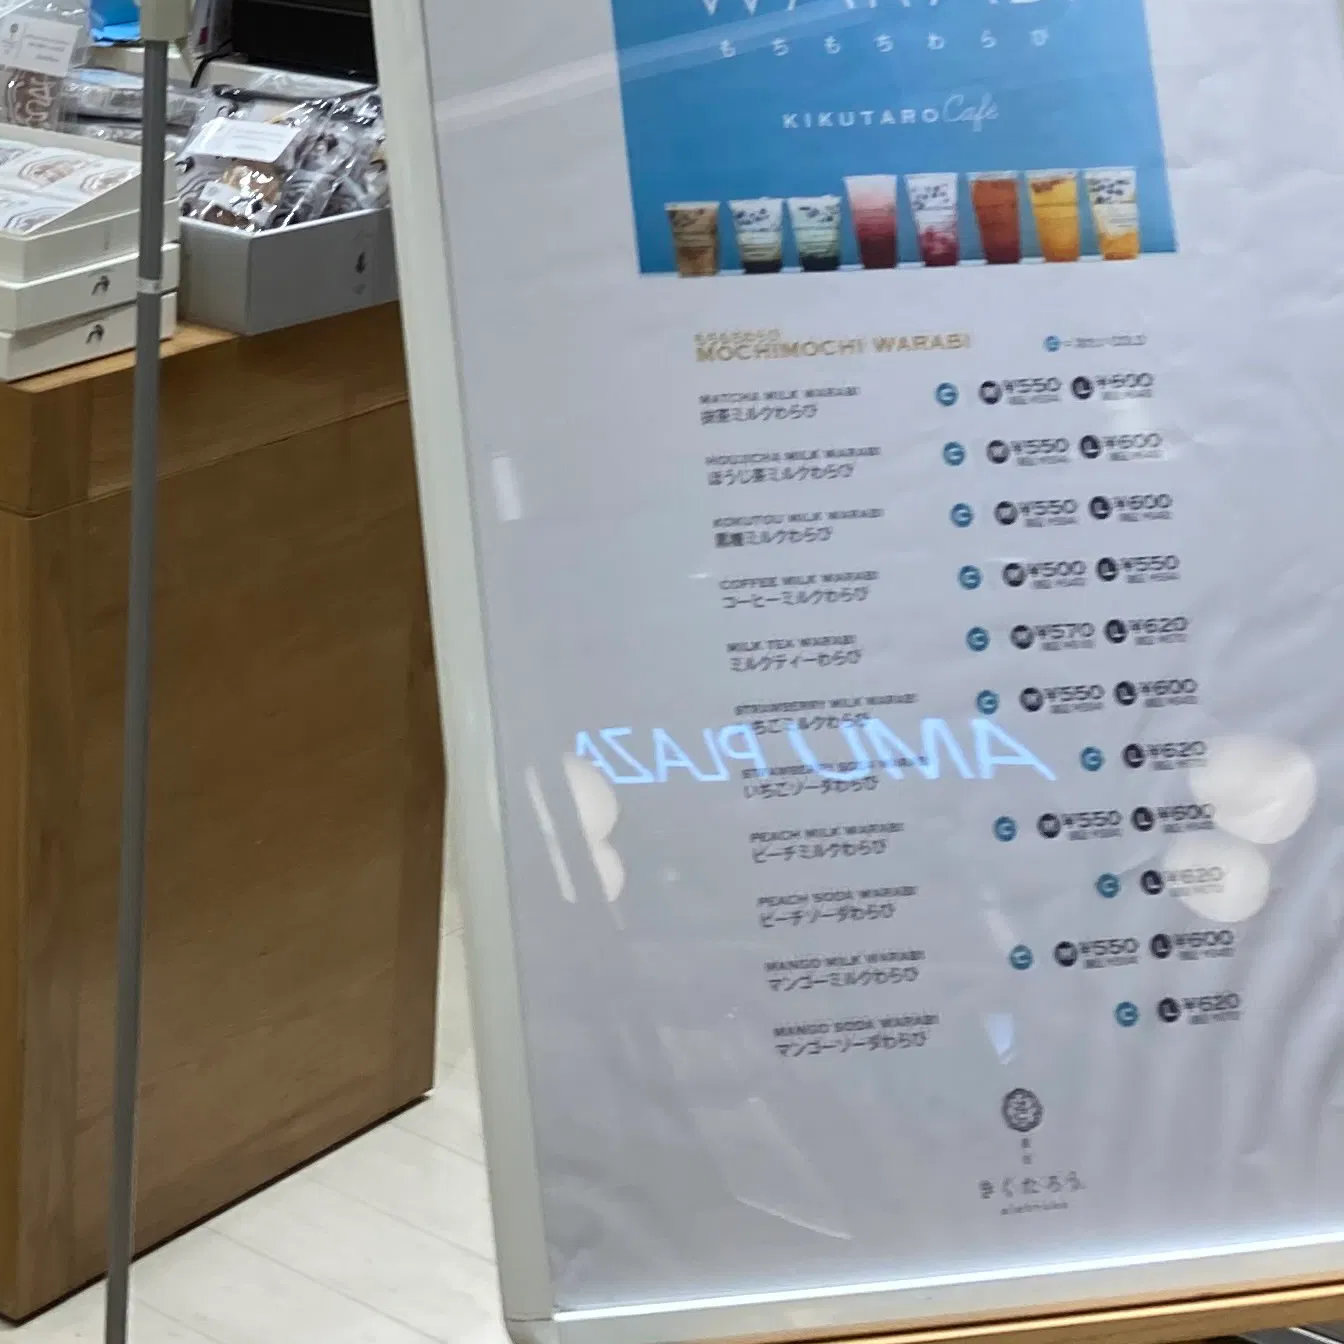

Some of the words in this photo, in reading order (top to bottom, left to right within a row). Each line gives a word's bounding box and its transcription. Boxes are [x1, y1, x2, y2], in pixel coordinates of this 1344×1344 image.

[782, 108, 939, 129] KIKUTARO
[872, 333, 971, 353] WARABI
[781, 574, 817, 586] MILK
[820, 570, 880, 583] WARABI
[726, 640, 762, 653] MILK
[798, 634, 857, 648] WARABI
[804, 827, 841, 839] MILK
[845, 822, 905, 835] WARABI
